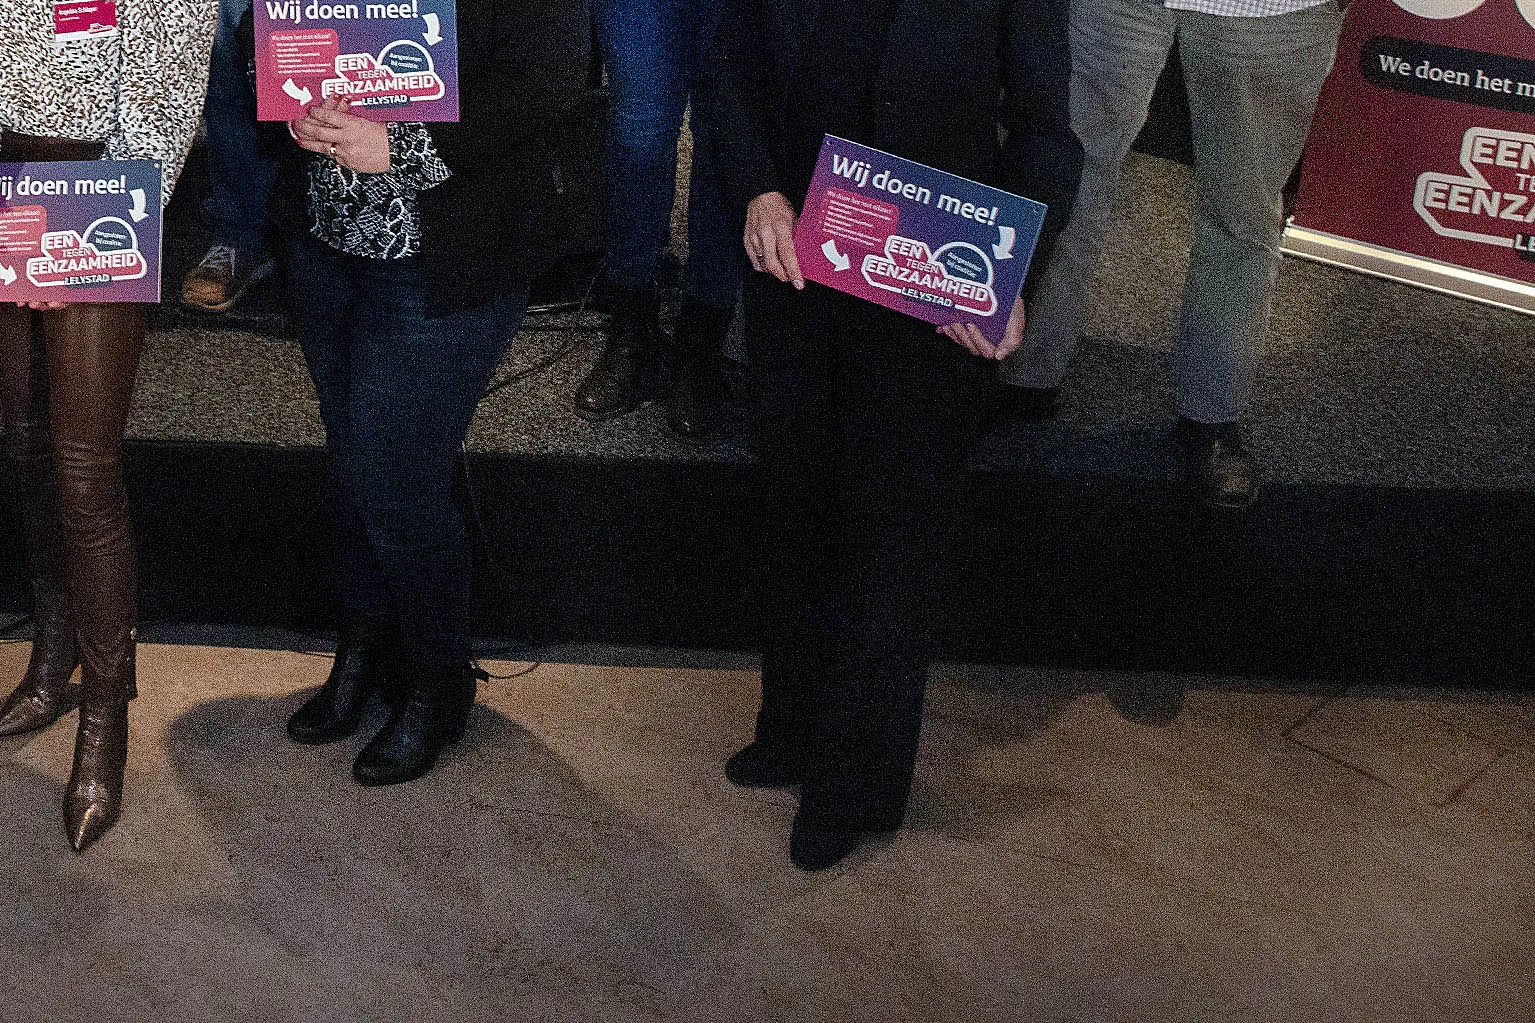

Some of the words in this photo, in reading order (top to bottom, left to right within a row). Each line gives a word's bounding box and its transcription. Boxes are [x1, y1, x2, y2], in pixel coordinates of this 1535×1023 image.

[266, 0, 301, 24] Wij
[305, 0, 359, 20] doen
[365, 0, 418, 19] mee!
[339, 57, 368, 71] EEN
[356, 69, 387, 79] TEGEN
[1379, 53, 1412, 76] We
[1415, 60, 1469, 87] doen
[1475, 69, 1512, 94] het
[325, 75, 435, 96] EENZAAMHEID
[362, 95, 407, 106] LELYSTAD
[17, 176, 69, 197] doen
[74, 175, 126, 195] mee!
[832, 154, 870, 188] Wij
[872, 170, 931, 205] doen
[937, 191, 999, 226] mee!
[45, 235, 74, 250] EEN
[62, 248, 91, 257] TEGEN
[889, 239, 924, 259] EEN
[30, 253, 137, 276] EENZAAMHEID
[905, 258, 939, 275] TEGEN
[65, 274, 110, 286] LELYSTAD
[866, 259, 989, 303] EENZAAMHEID
[901, 286, 953, 308] LELYSTAD
